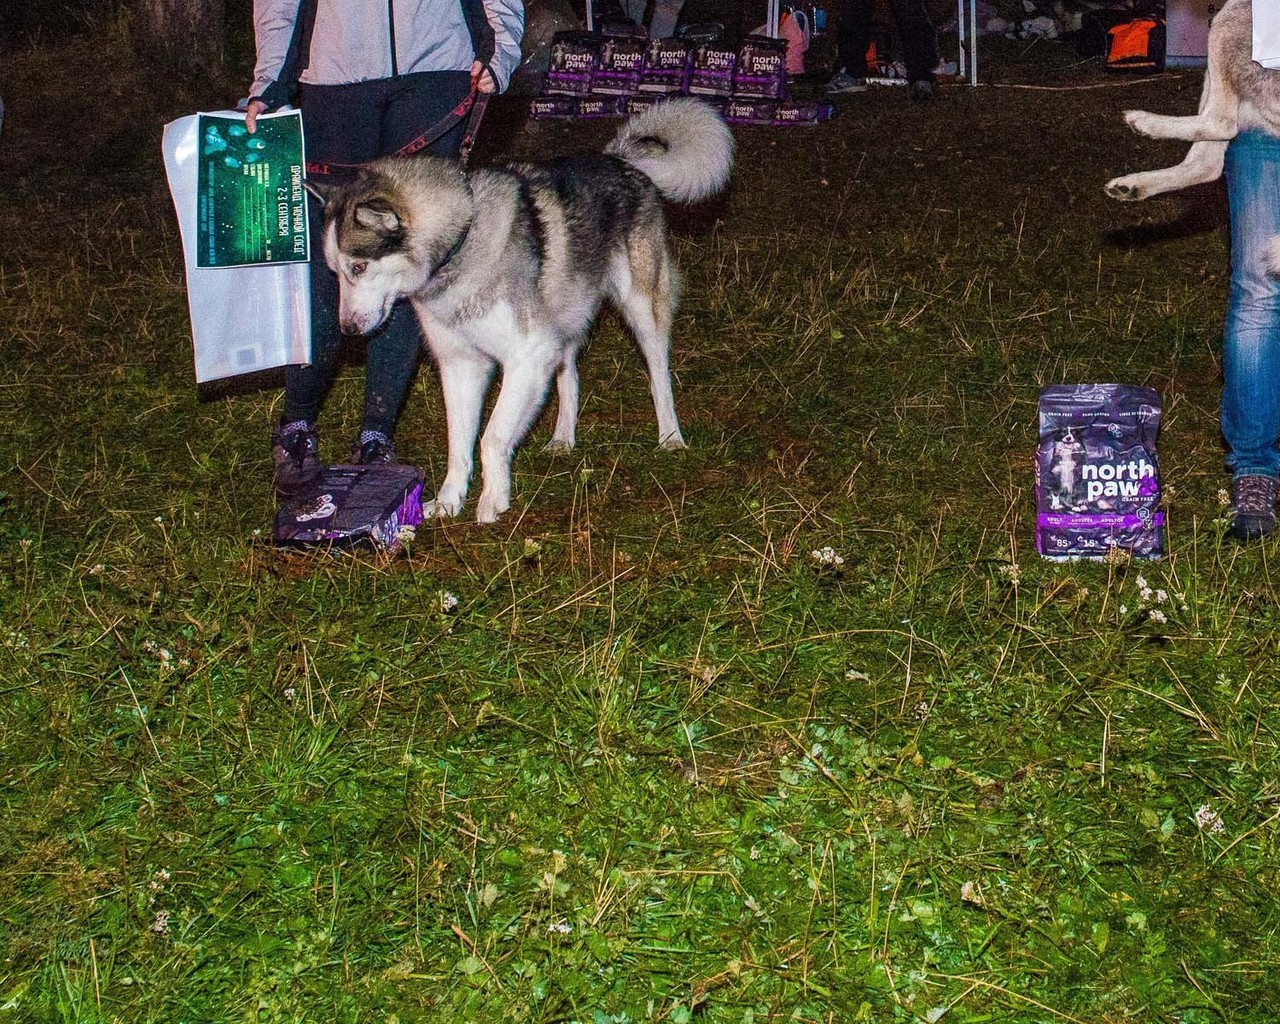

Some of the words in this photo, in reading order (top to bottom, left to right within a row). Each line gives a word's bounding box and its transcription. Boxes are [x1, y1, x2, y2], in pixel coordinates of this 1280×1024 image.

[565, 53, 593, 62] north
[613, 52, 641, 61] north
[660, 49, 686, 58] north
[707, 50, 736, 59] north
[566, 60, 587, 69] paw
[614, 59, 635, 68] paw
[661, 57, 680, 65] paw
[707, 57, 729, 66] paw
[752, 56, 781, 64] north
[753, 63, 775, 72] paw
[277, 187, 288, 200] 2-3
[278, 202, 289, 236] СЕНТЯБРЯ
[1082, 459, 1154, 480] north
[1087, 480, 1141, 502] paw
